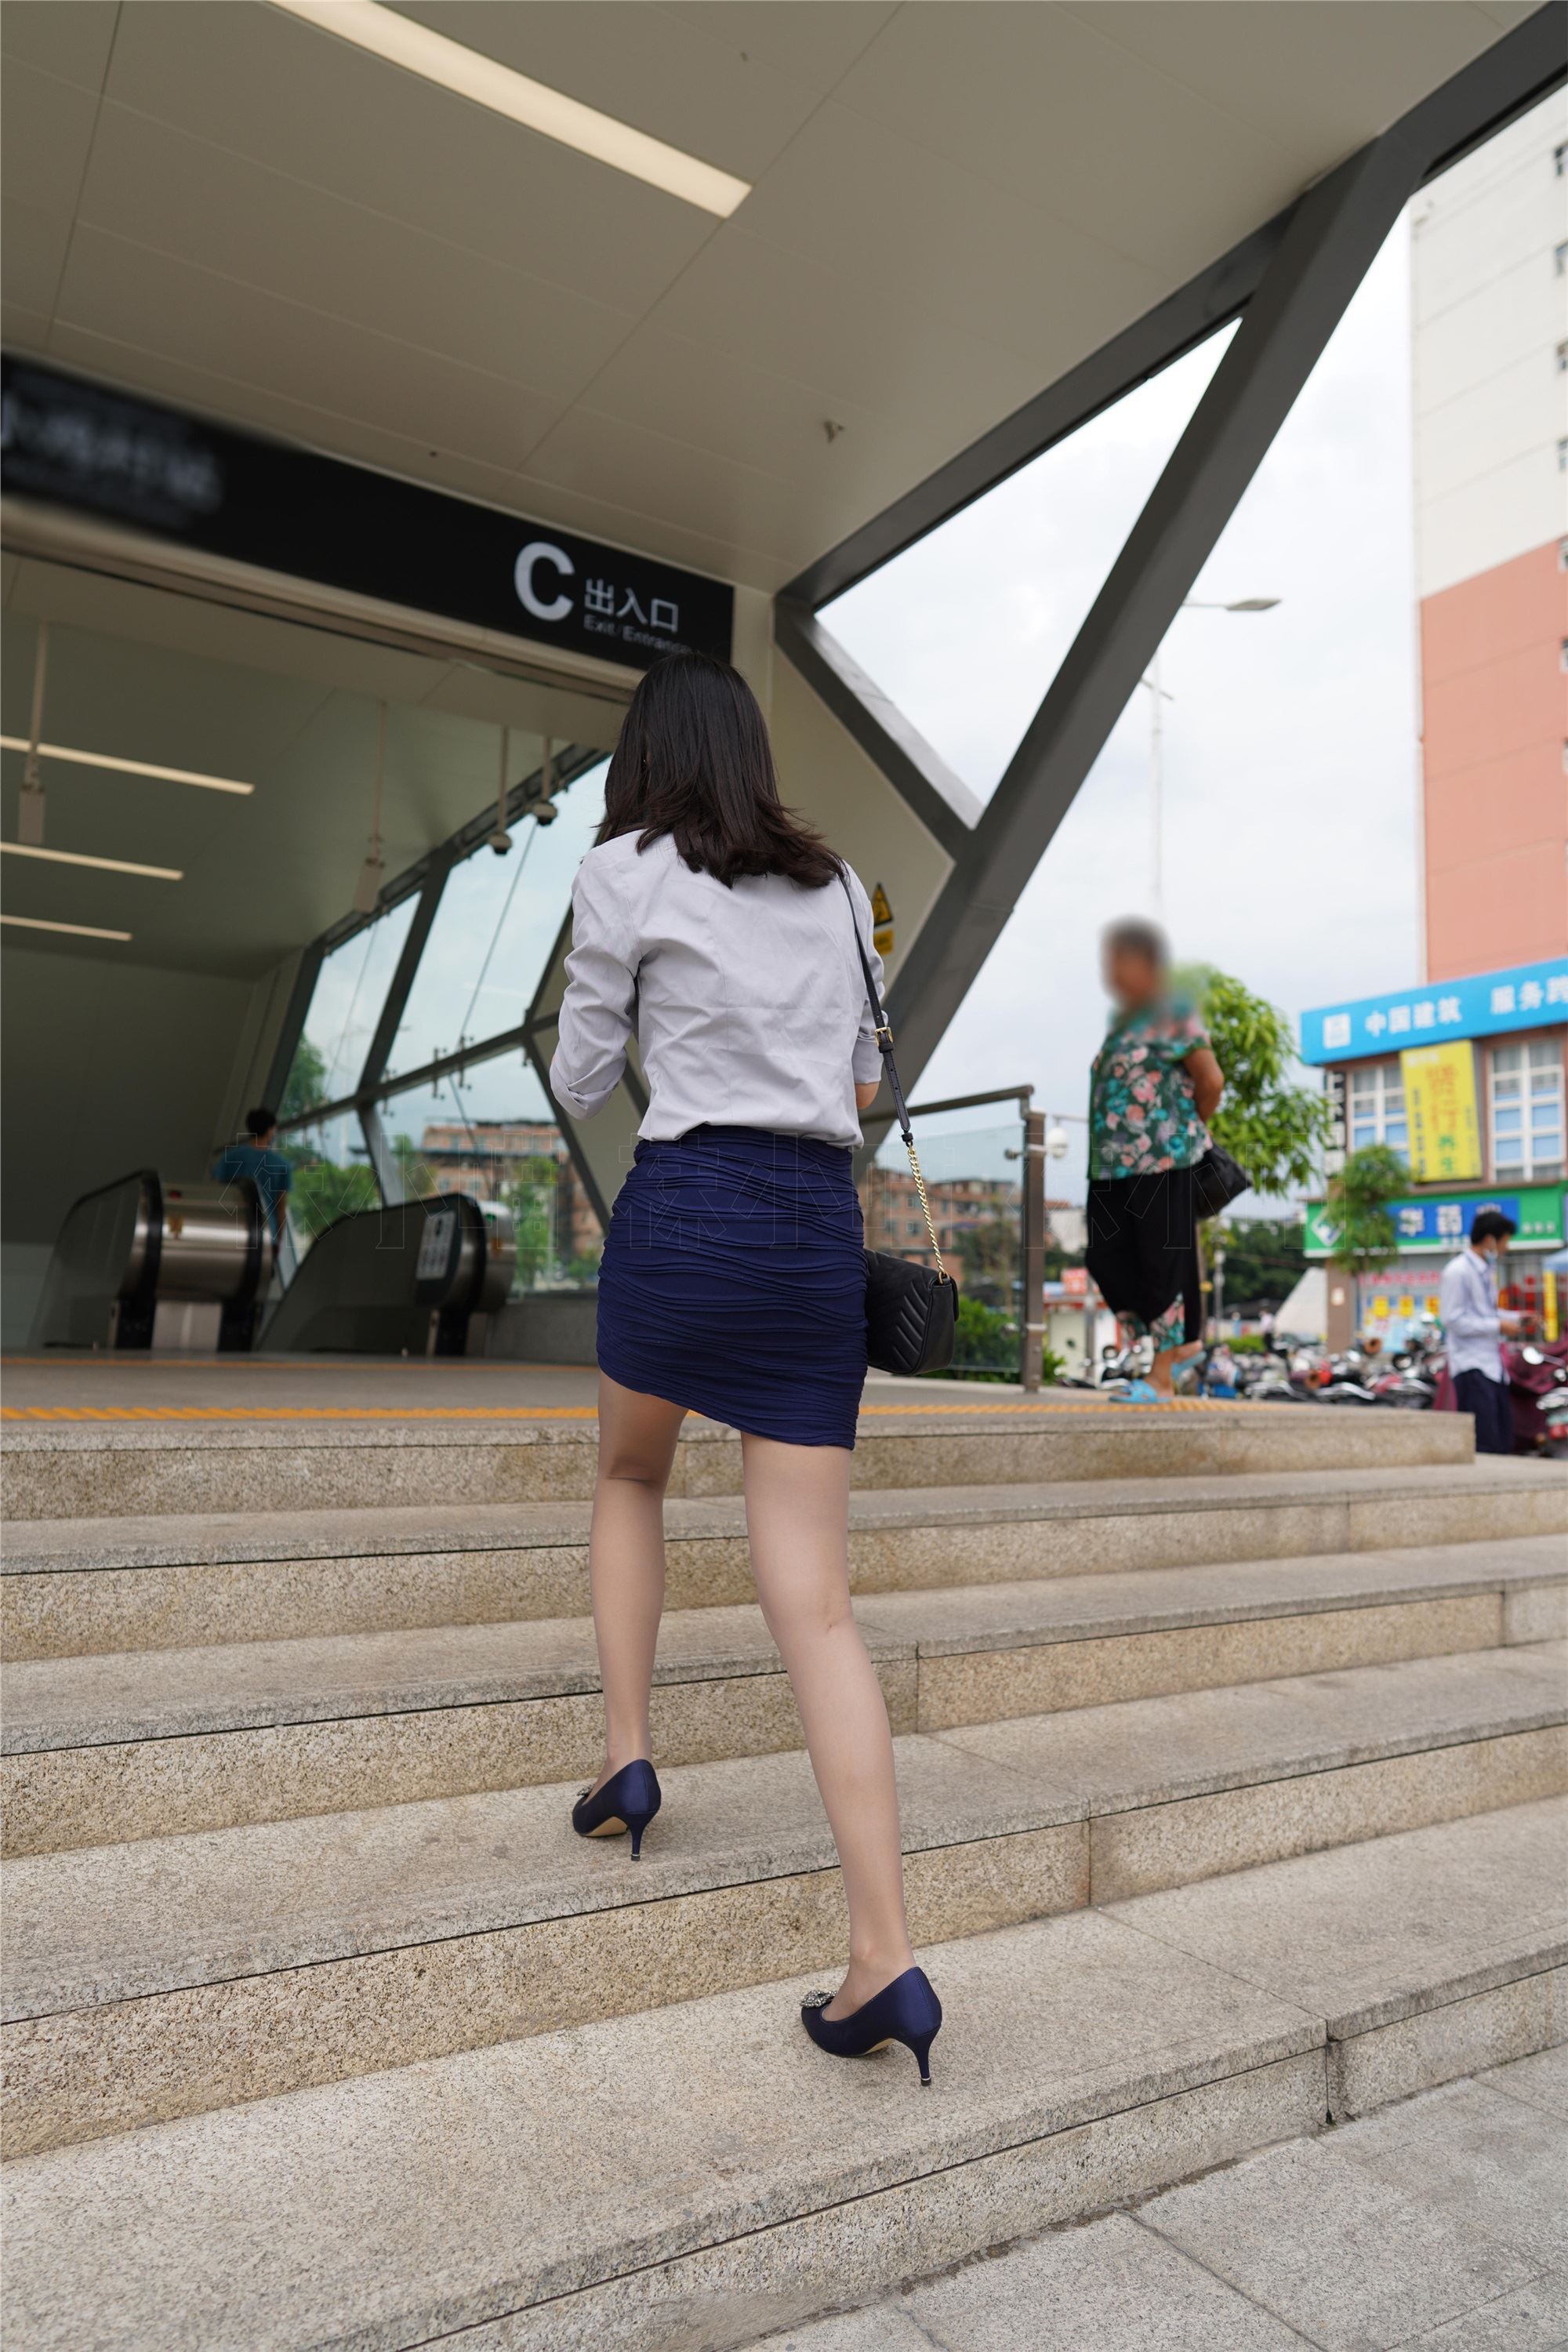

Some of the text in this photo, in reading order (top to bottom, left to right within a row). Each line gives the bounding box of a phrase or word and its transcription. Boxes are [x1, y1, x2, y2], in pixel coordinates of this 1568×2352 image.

[514, 541, 575, 622] C
[584, 578, 679, 633] 出入口
[1365, 995, 1463, 1037] 中国建筑
